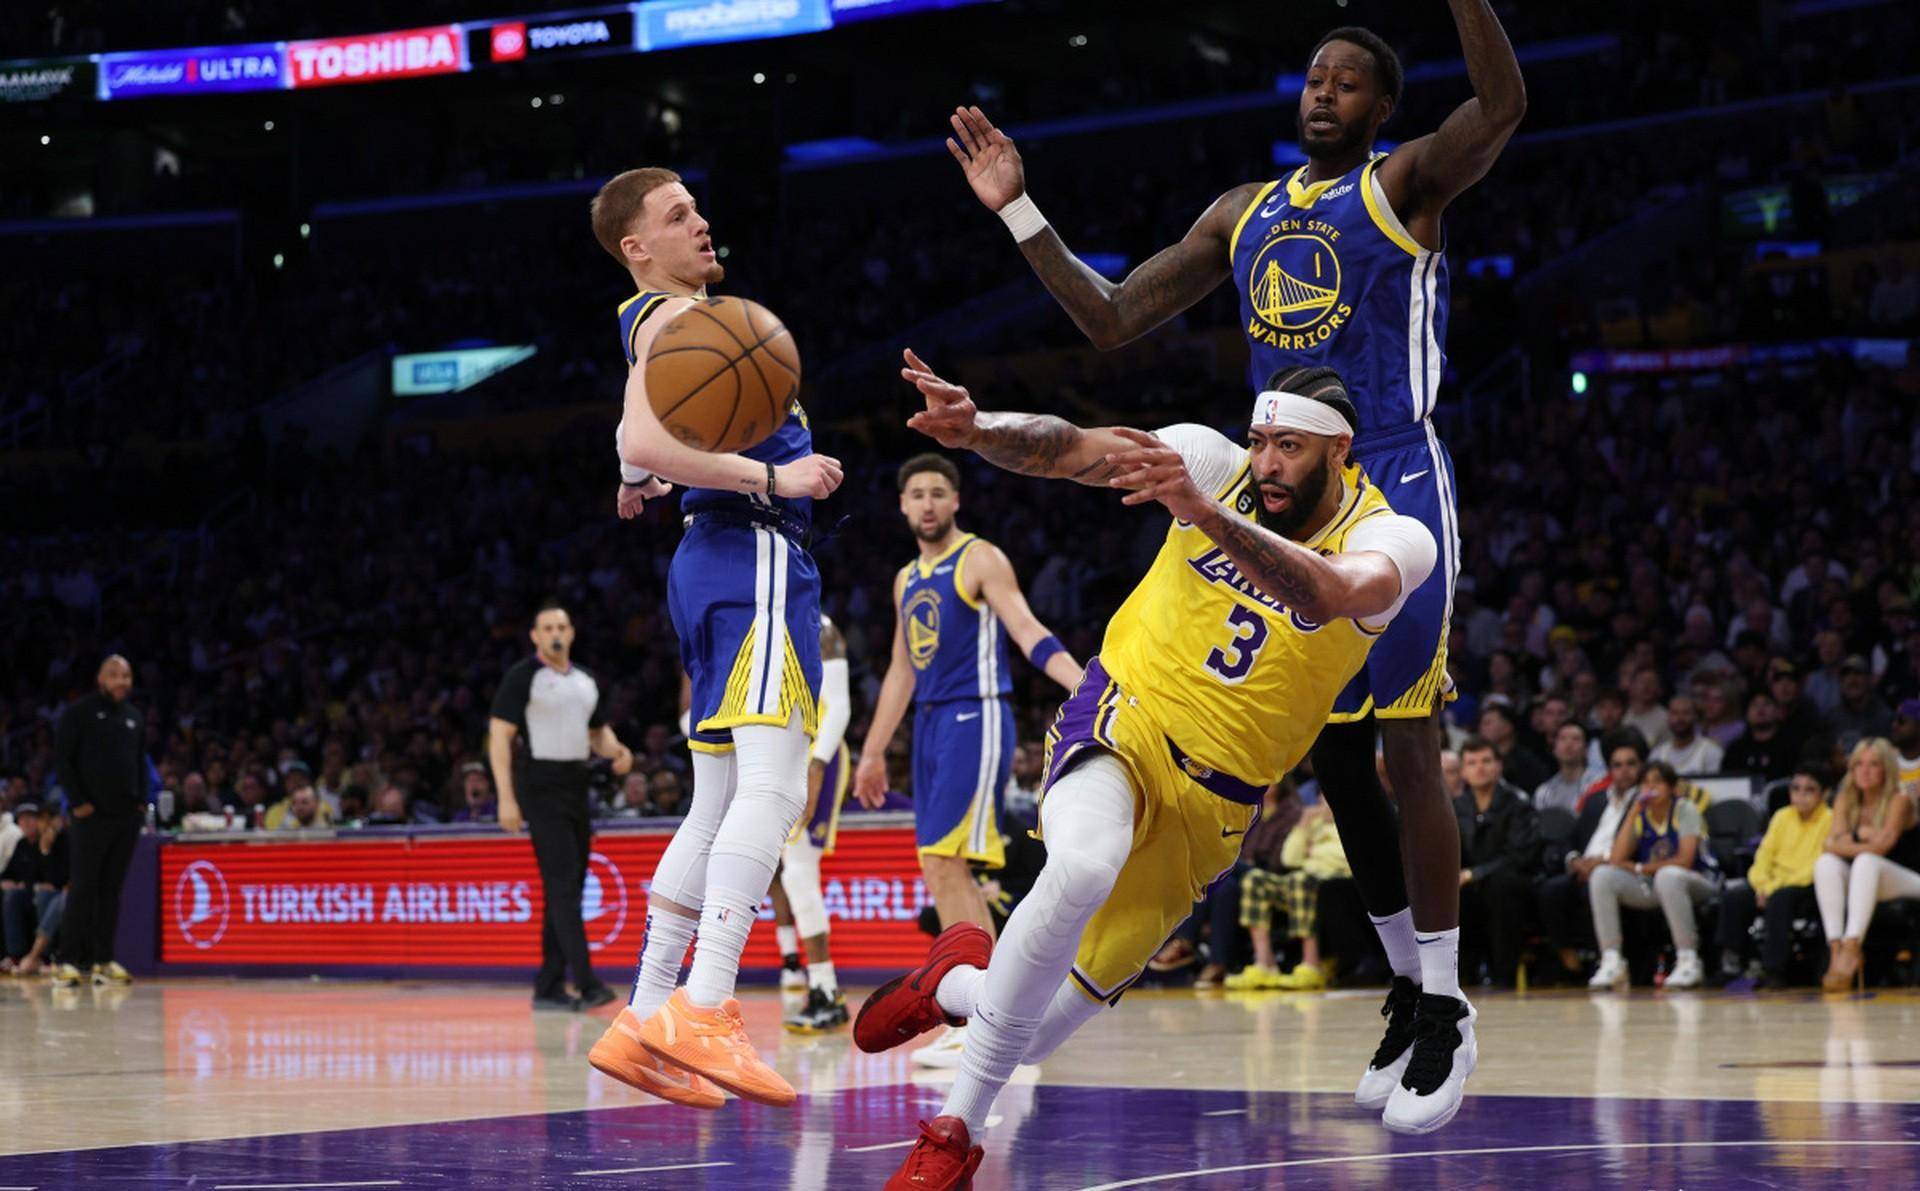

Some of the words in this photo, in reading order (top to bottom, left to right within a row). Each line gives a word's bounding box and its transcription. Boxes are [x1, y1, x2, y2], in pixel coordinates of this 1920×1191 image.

[527, 20, 610, 49] TOYOTA
[200, 55, 278, 81] ULTRA
[294, 33, 455, 80] TOSHIBA
[1307, 220, 1341, 242] STATE
[1314, 252, 1321, 278] 1
[1247, 302, 1352, 350] WARRIORS
[1238, 494, 1252, 512] 6
[1203, 602, 1270, 686] 3
[240, 883, 374, 923] TURKISH
[381, 880, 533, 923] AIRLINES
[823, 877, 936, 921] AIRLI
